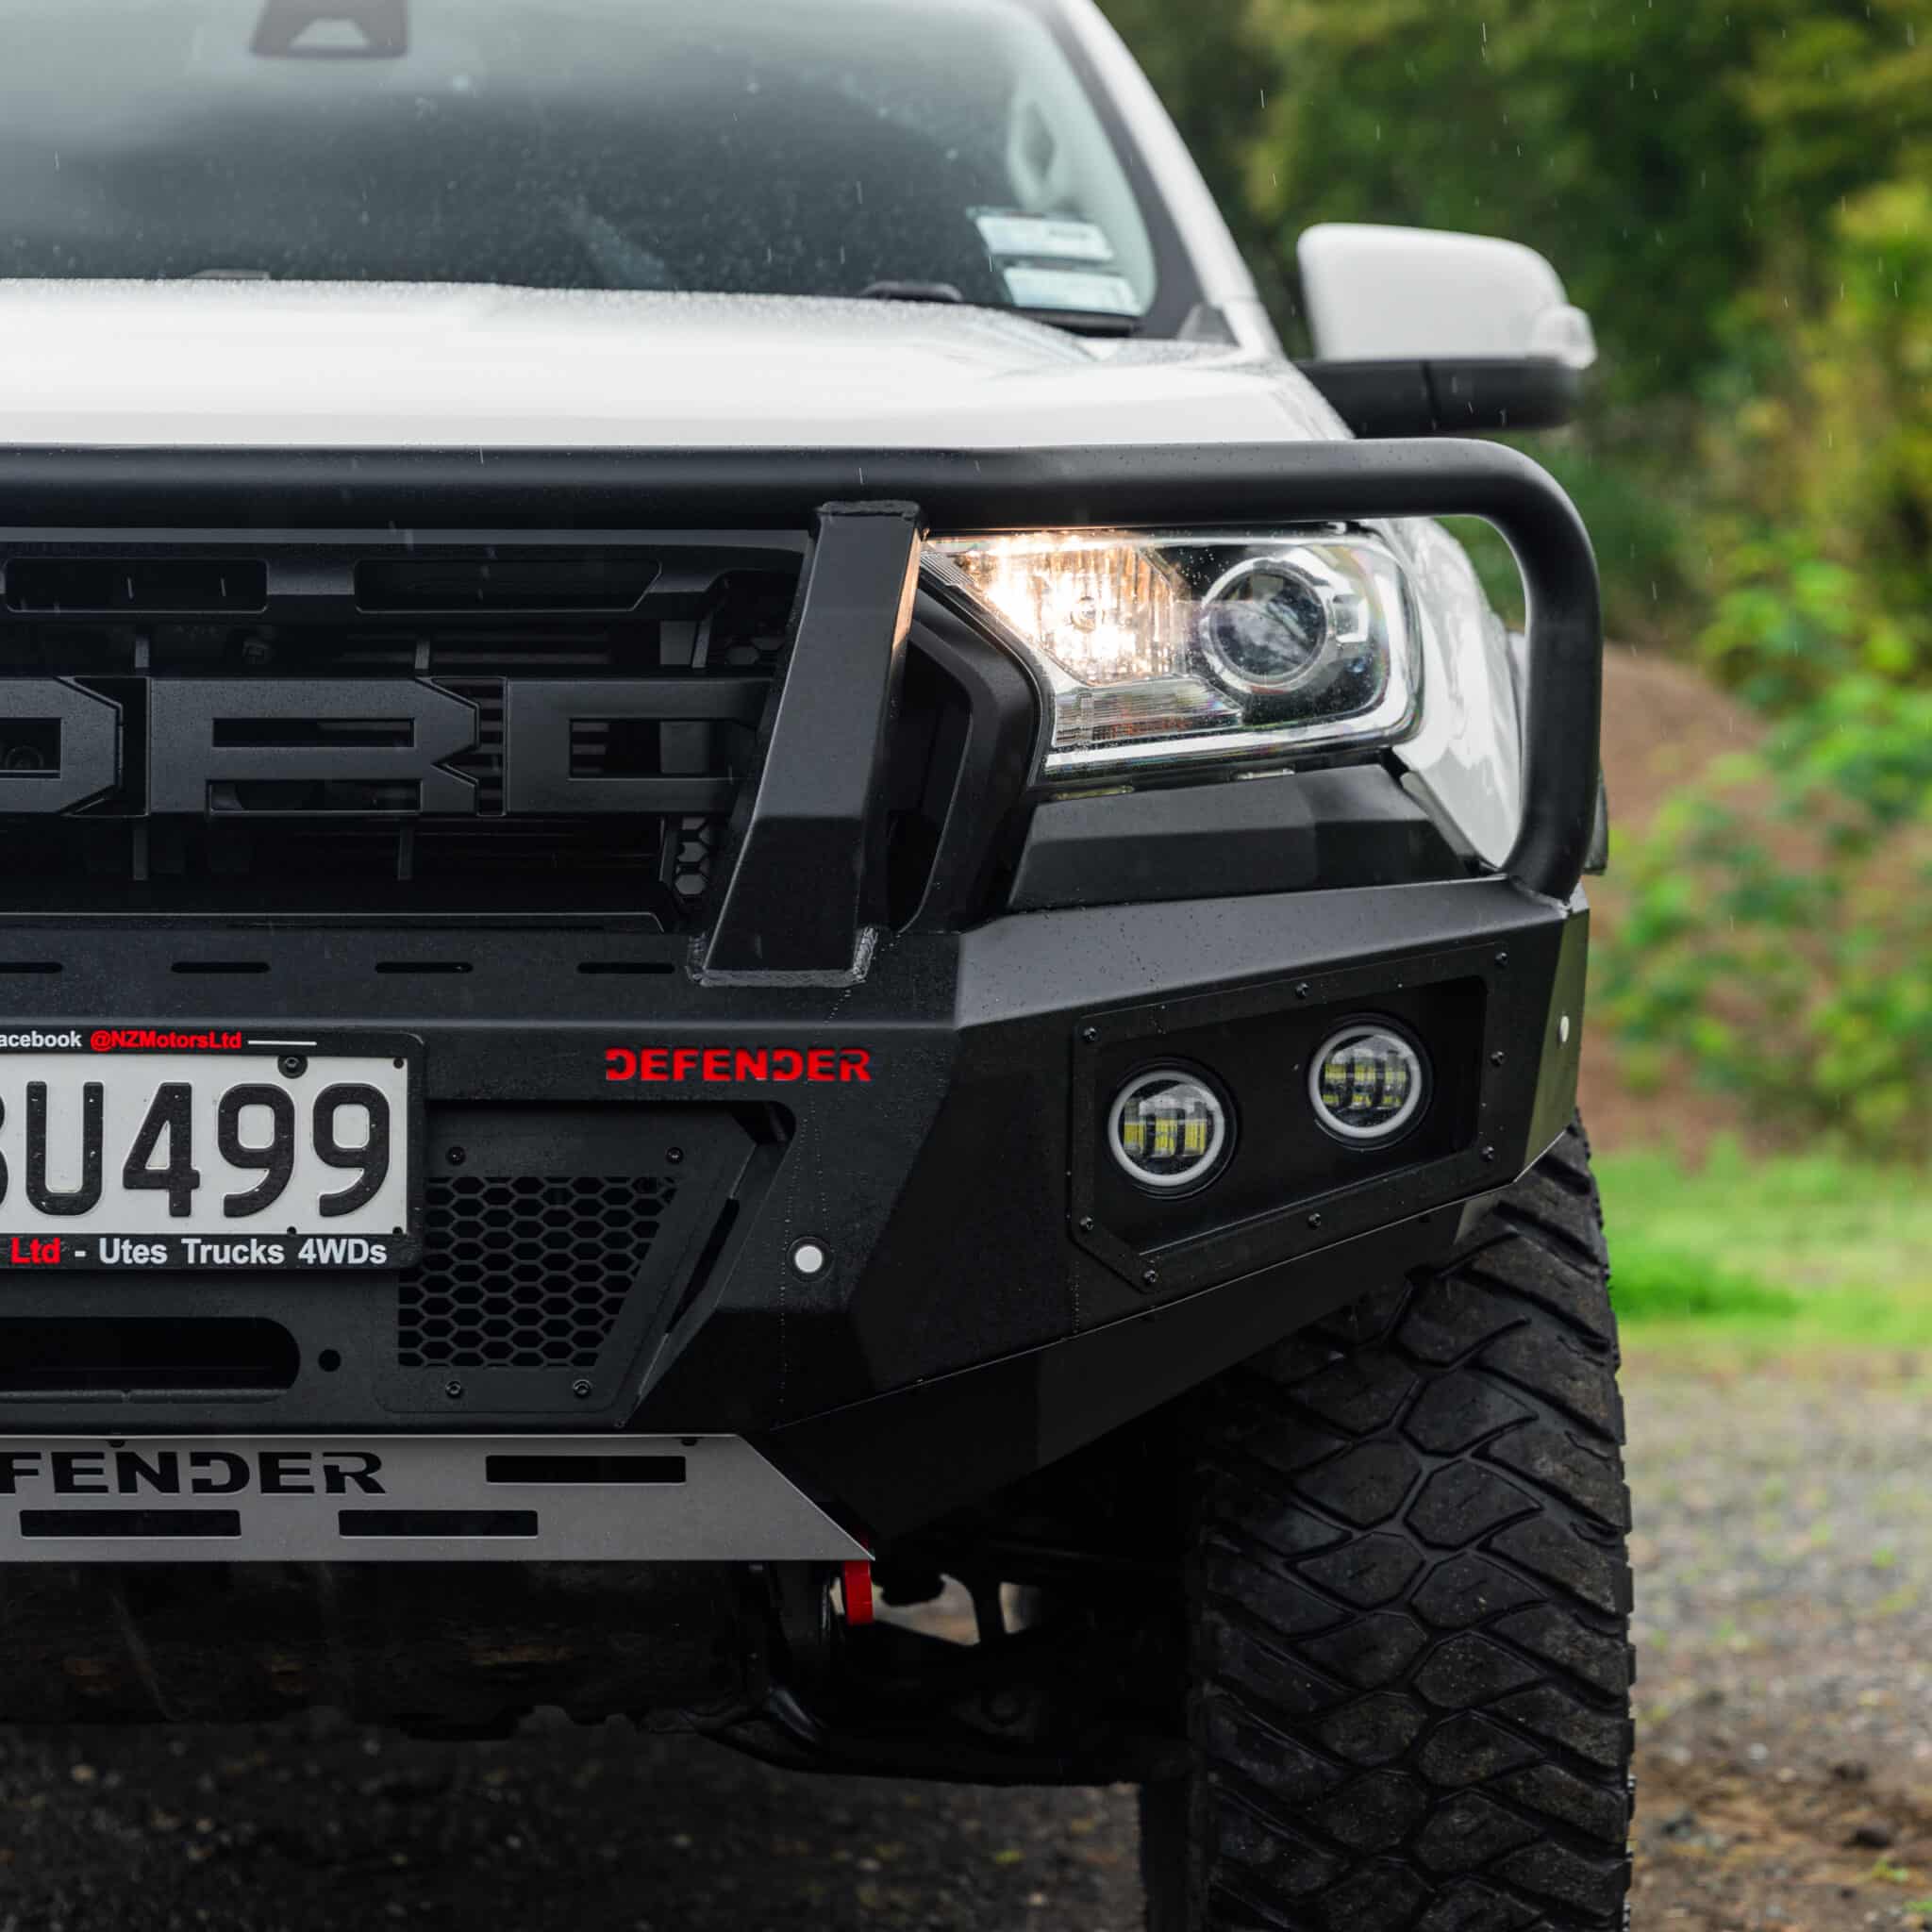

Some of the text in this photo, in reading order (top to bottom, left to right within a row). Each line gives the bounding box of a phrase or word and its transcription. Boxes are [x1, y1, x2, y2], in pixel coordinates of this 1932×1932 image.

[90, 1030, 242, 1052] @NZMotorsLtd
[605, 1048, 871, 1081] DEFENDER
[0, 1081, 390, 1217] U499
[11, 1238, 60, 1263] Ltd
[99, 1238, 168, 1264] Utes
[181, 1238, 285, 1265] Trucks
[298, 1238, 388, 1264] 4WDs
